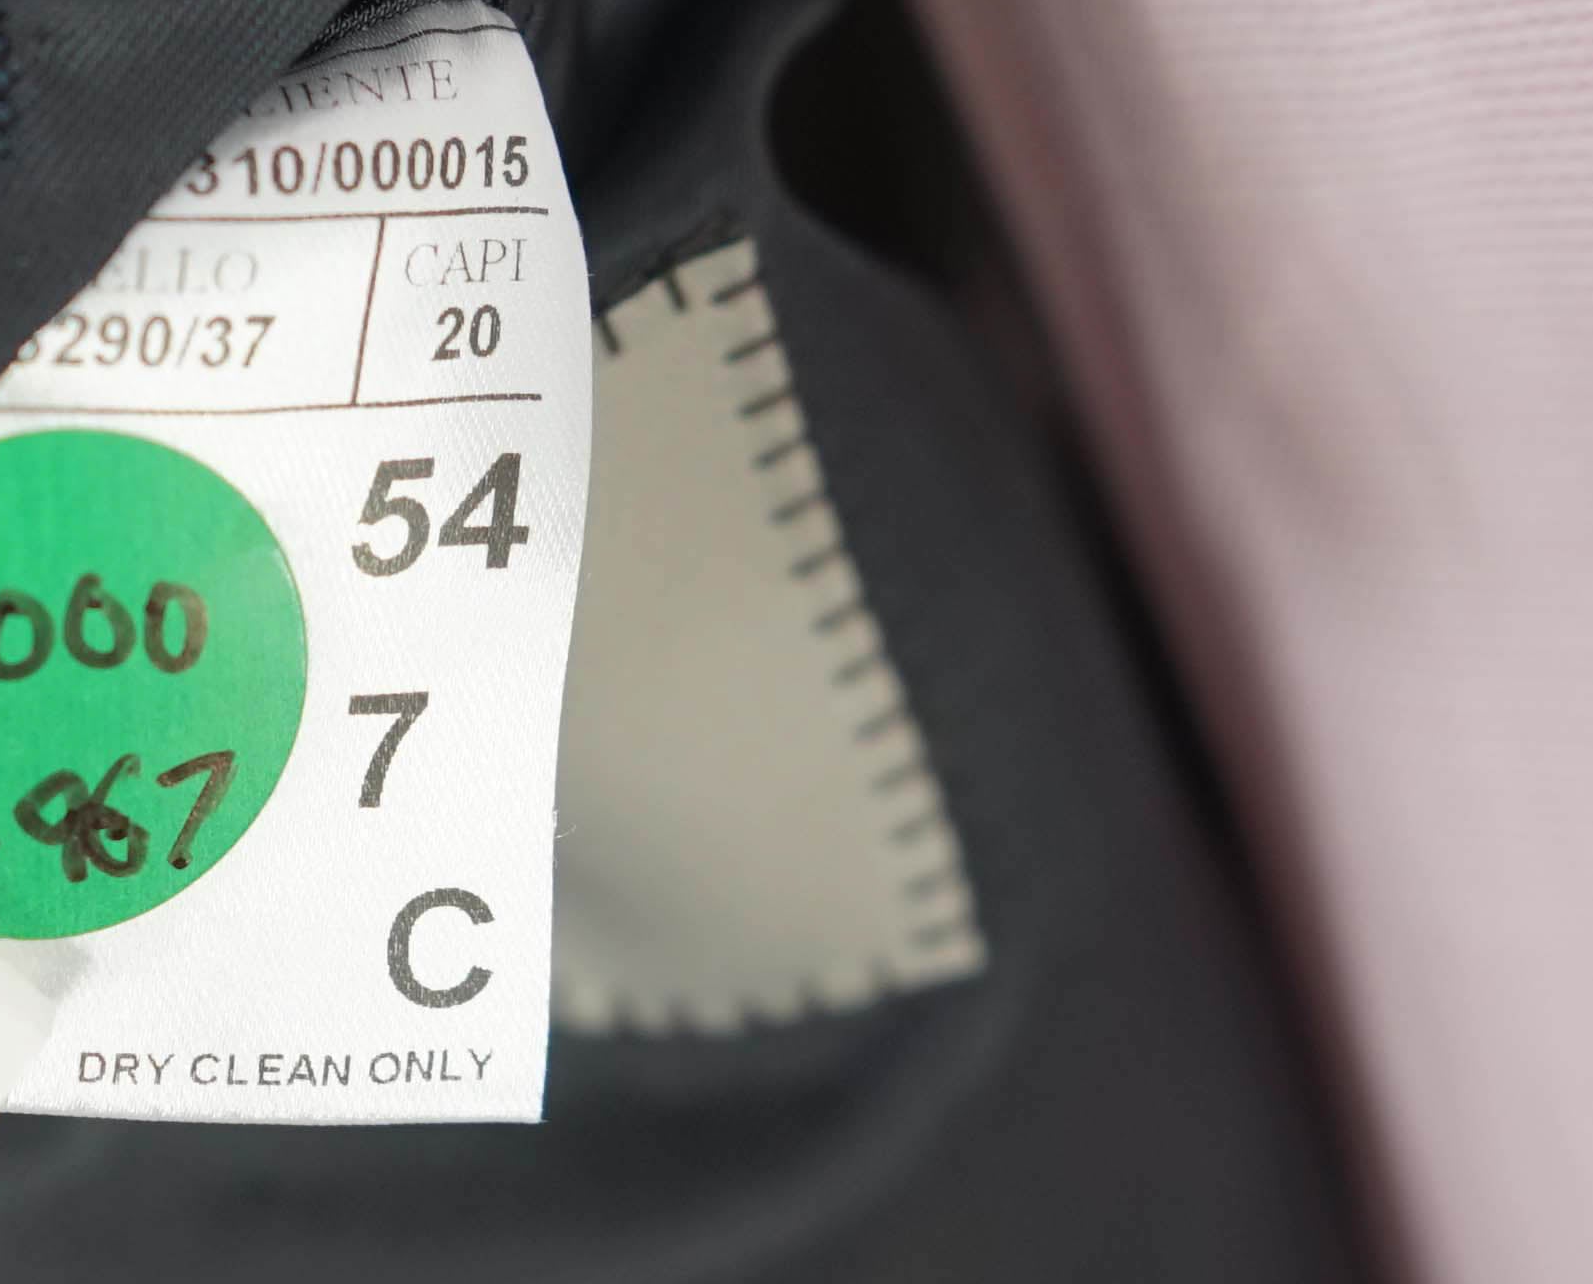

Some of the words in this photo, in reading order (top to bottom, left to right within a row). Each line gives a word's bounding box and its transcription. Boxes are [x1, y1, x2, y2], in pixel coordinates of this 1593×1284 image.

[238, 59, 458, 117] IENTE
[405, 237, 528, 288] CAPI
[431, 303, 501, 362] 20
[351, 452, 530, 578] 54
[348, 691, 430, 809] 7
[386, 886, 496, 1010] C
[78, 1050, 176, 1086] DRY
[189, 1051, 351, 1086] CLEAN
[368, 1046, 494, 1085] ONLY
